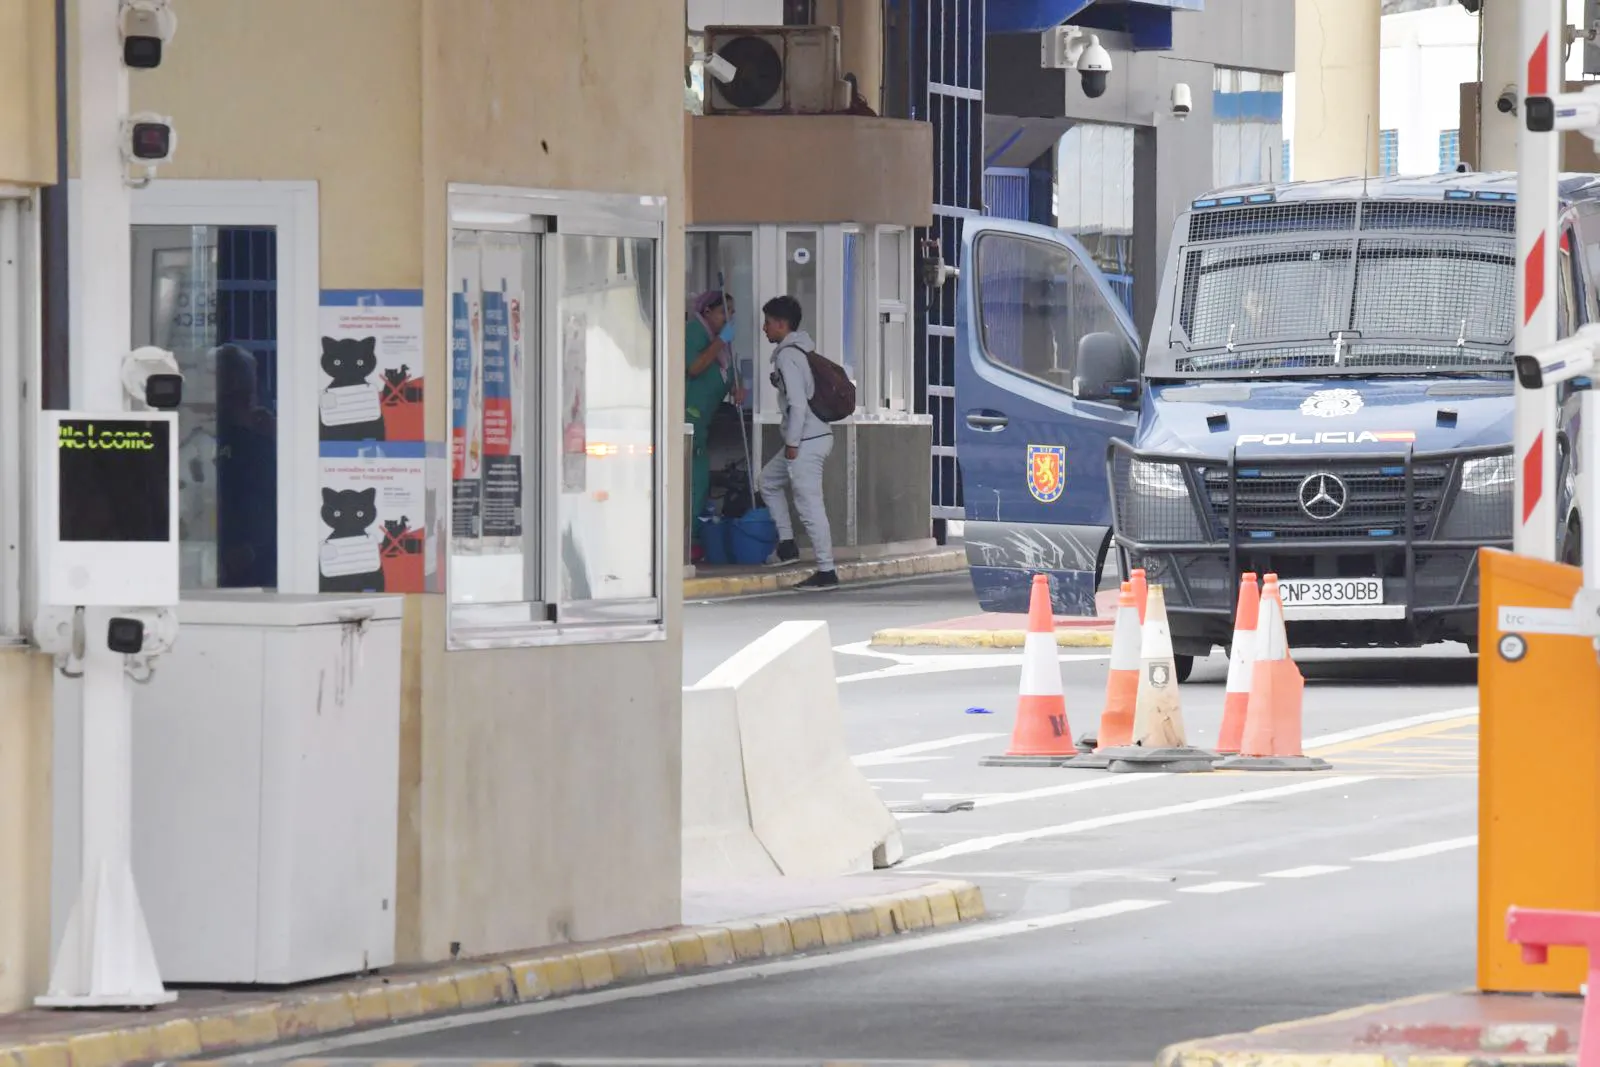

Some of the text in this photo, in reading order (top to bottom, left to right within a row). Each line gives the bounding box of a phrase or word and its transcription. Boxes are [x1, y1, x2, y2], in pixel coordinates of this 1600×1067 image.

[58, 424, 154, 449] Welcome
[1235, 430, 1379, 447] POLICIA
[1279, 582, 1379, 601] CNP3830BB
